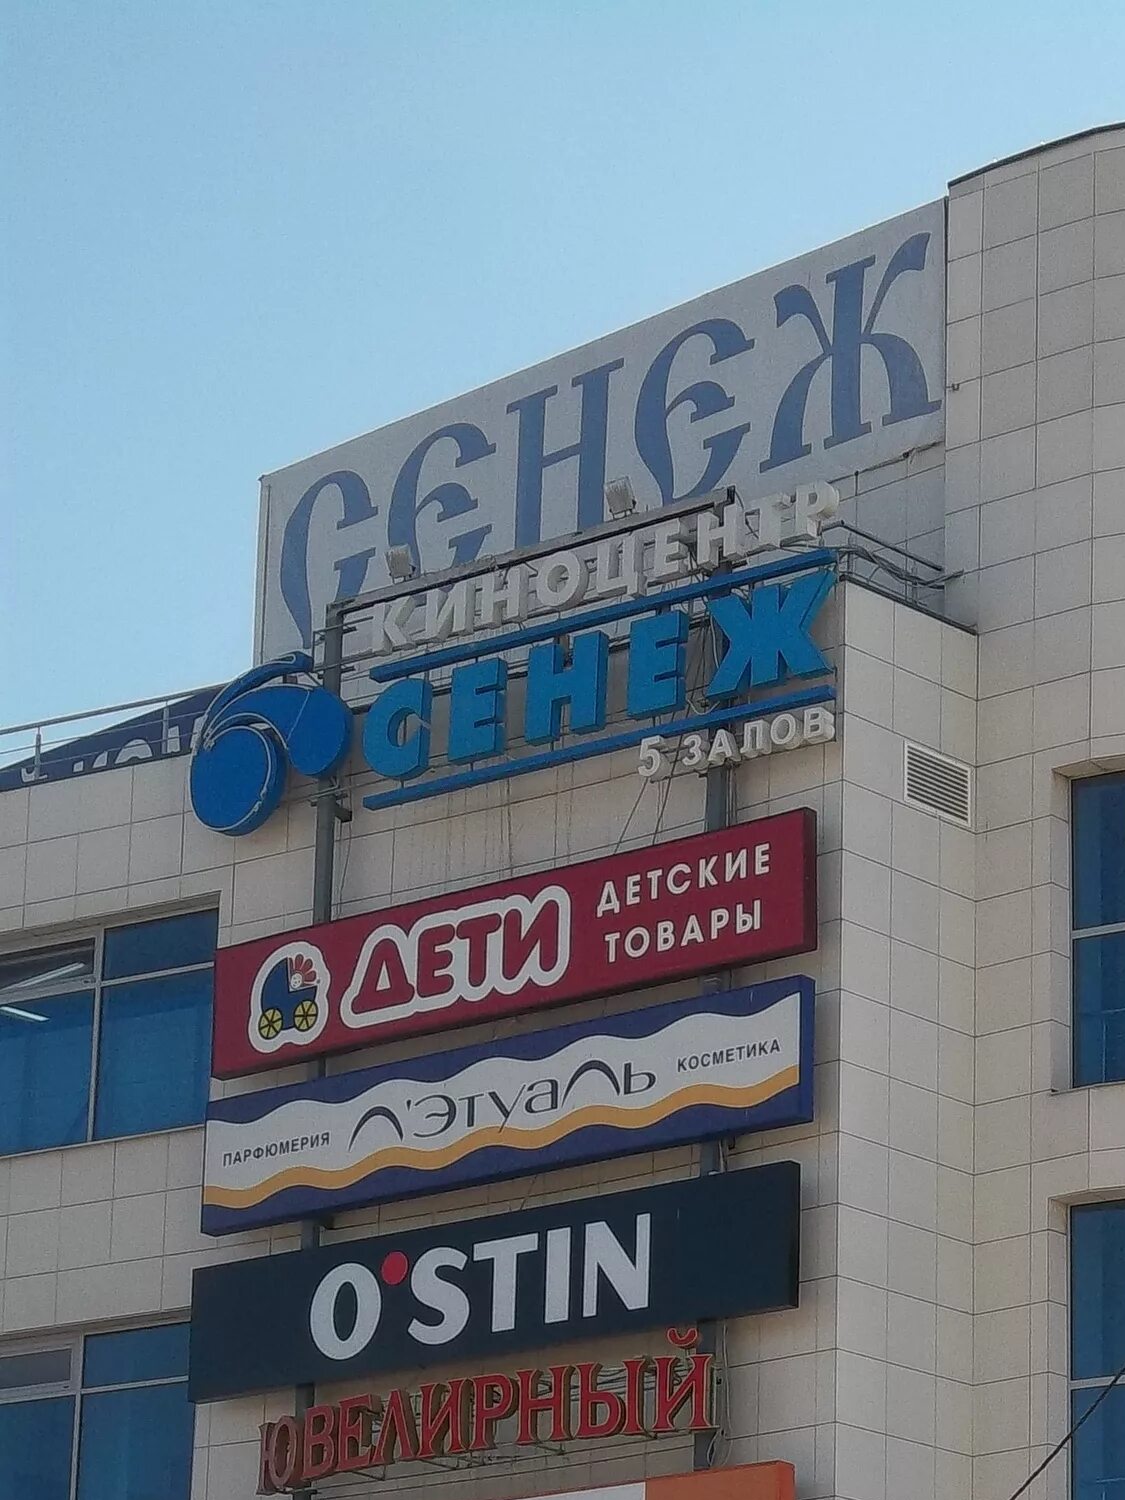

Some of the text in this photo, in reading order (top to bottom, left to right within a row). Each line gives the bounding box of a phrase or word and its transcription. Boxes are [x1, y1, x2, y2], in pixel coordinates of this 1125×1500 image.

[367, 480, 842, 658] КИНОЦЕНТР
[363, 568, 836, 780] СЕНЕЖ
[637, 704, 836, 781] 5 ЗАЛОВ
[596, 842, 772, 918] ДЕТСКИЕ
[605, 899, 763, 964] ТОВАРЫ
[346, 891, 567, 1022] ДЕТИ
[222, 1132, 331, 1167] ПАРФЮМЕРИЯ
[676, 1037, 781, 1075] КОСМЕТИКА
[258, 1326, 714, 1496] ЮВЕЛИРНЫЙ
